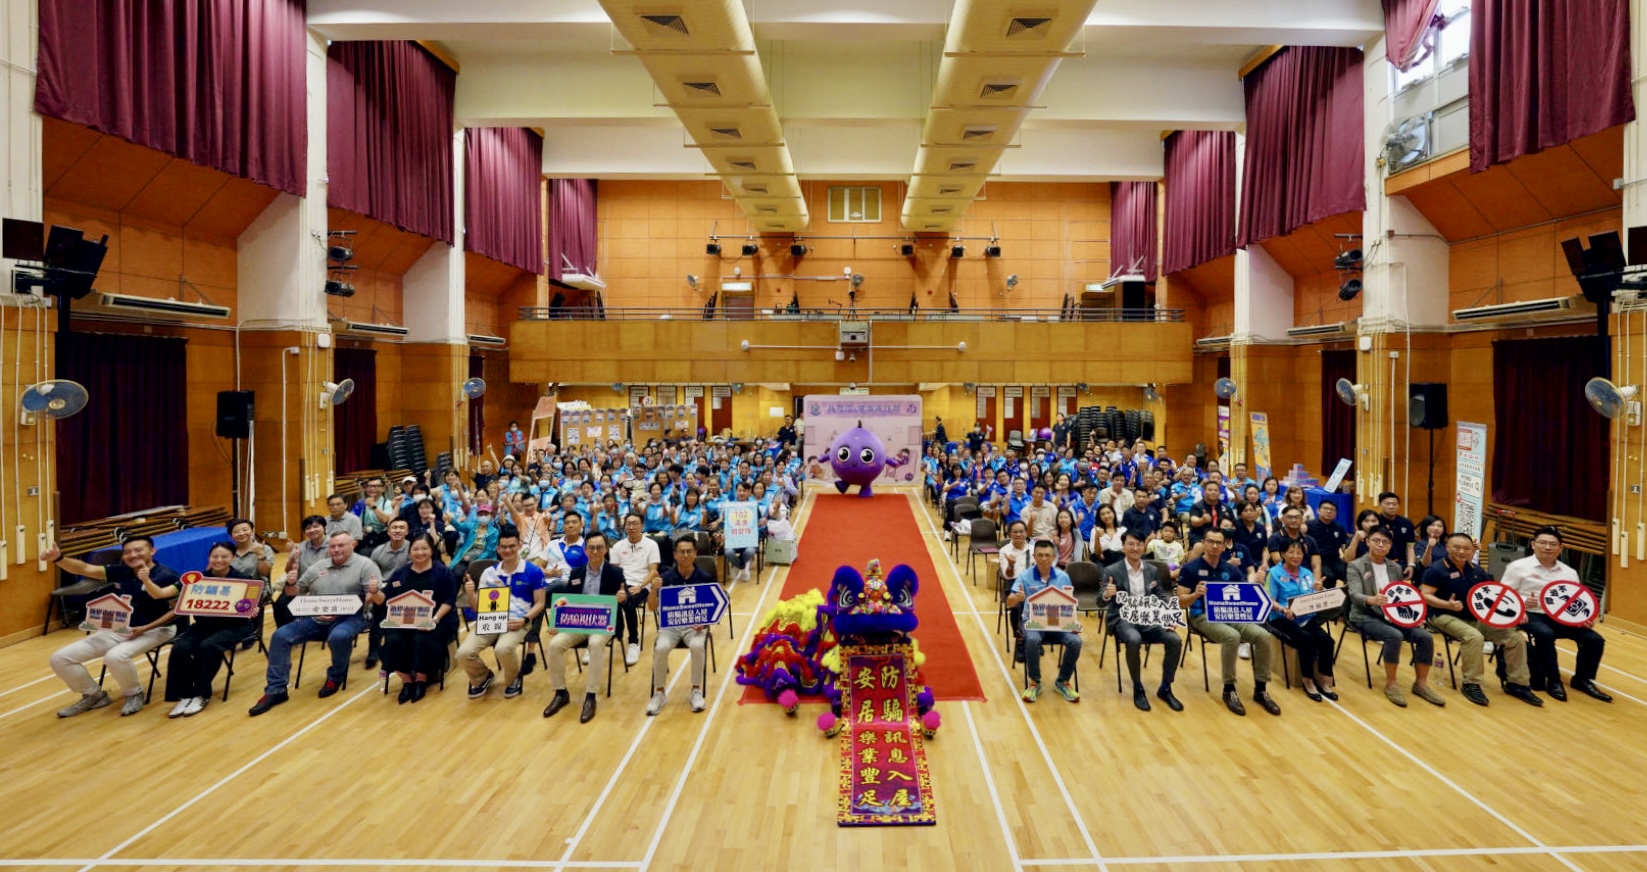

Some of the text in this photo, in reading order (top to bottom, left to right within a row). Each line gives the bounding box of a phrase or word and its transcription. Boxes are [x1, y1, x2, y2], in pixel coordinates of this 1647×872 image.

[185, 599, 230, 610] 18222
[854, 666, 883, 807] 安居樂業豐足
[880, 665, 914, 807] 防騙訊息入屋
